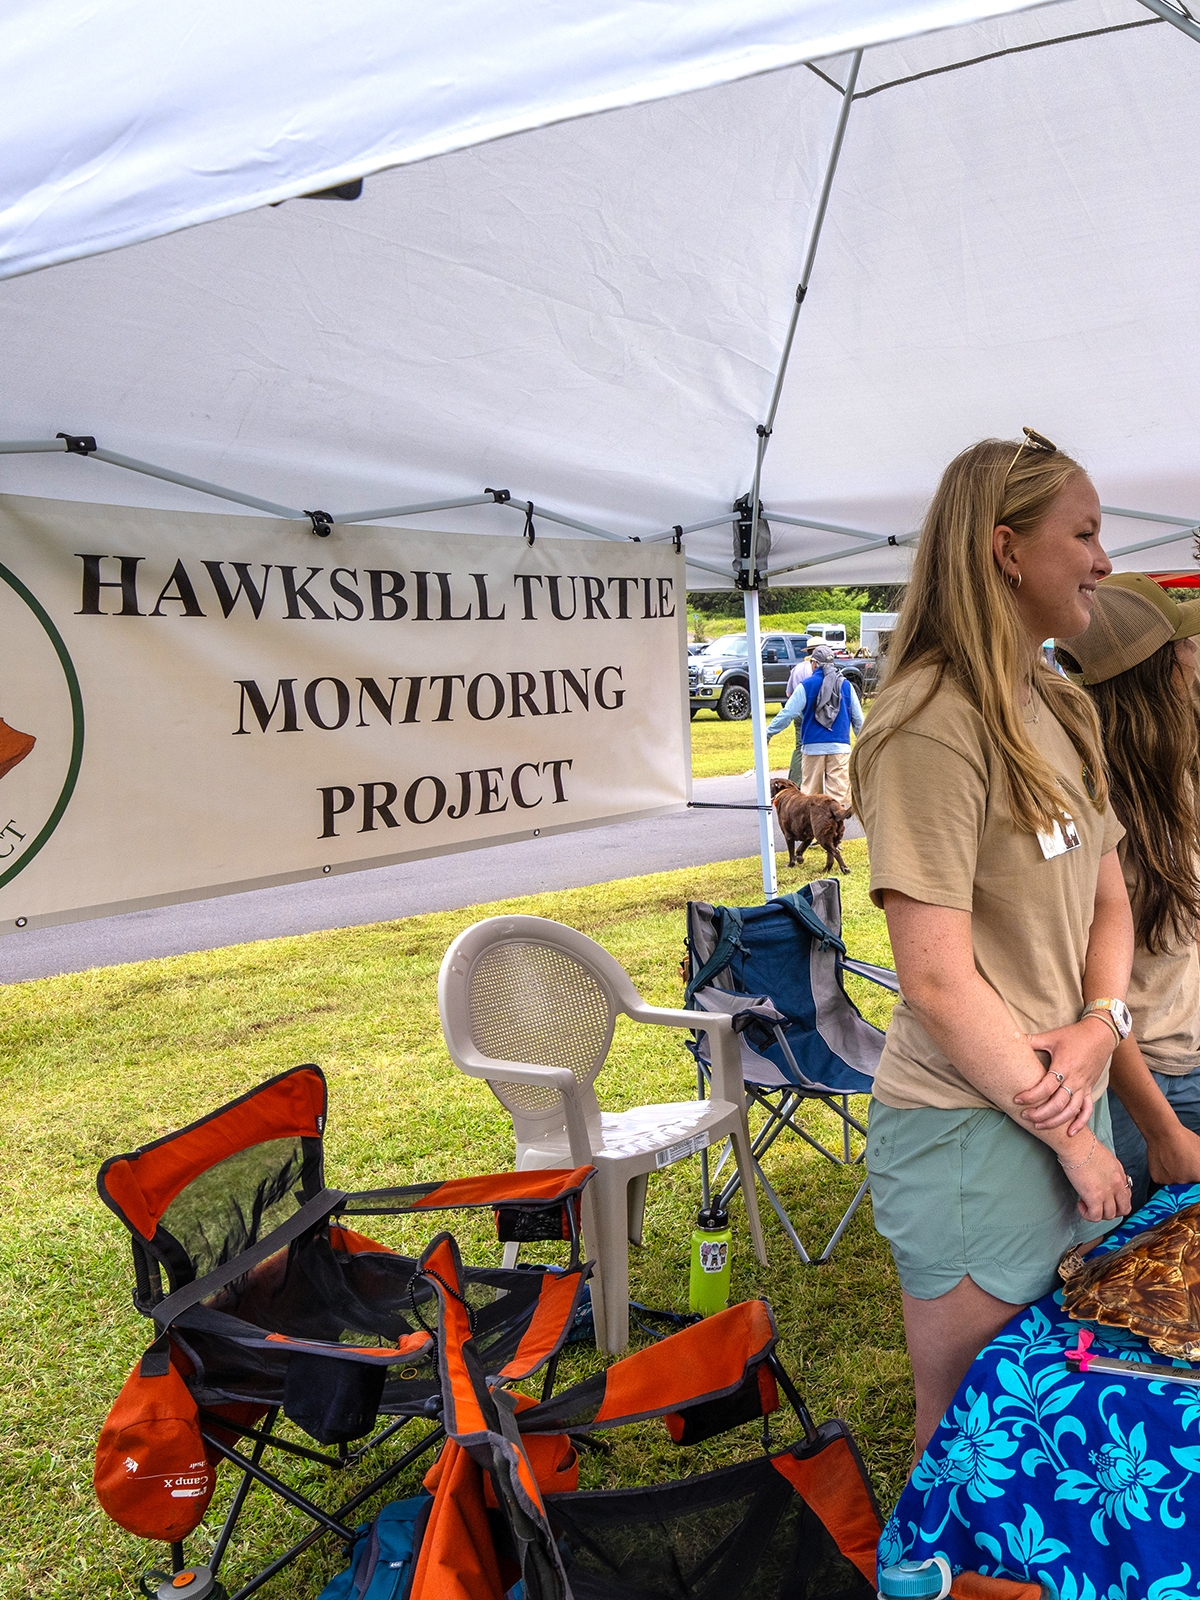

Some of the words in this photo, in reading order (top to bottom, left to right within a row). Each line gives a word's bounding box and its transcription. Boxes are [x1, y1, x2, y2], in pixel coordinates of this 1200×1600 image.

[74, 553, 506, 621] HAWKSBILL
[514, 574, 676, 621] TURTLE
[232, 665, 626, 737] MONITORING
[316, 758, 573, 839] PROJECT
[164, 1479, 173, 1488] X
[175, 1476, 208, 1486] Camp
